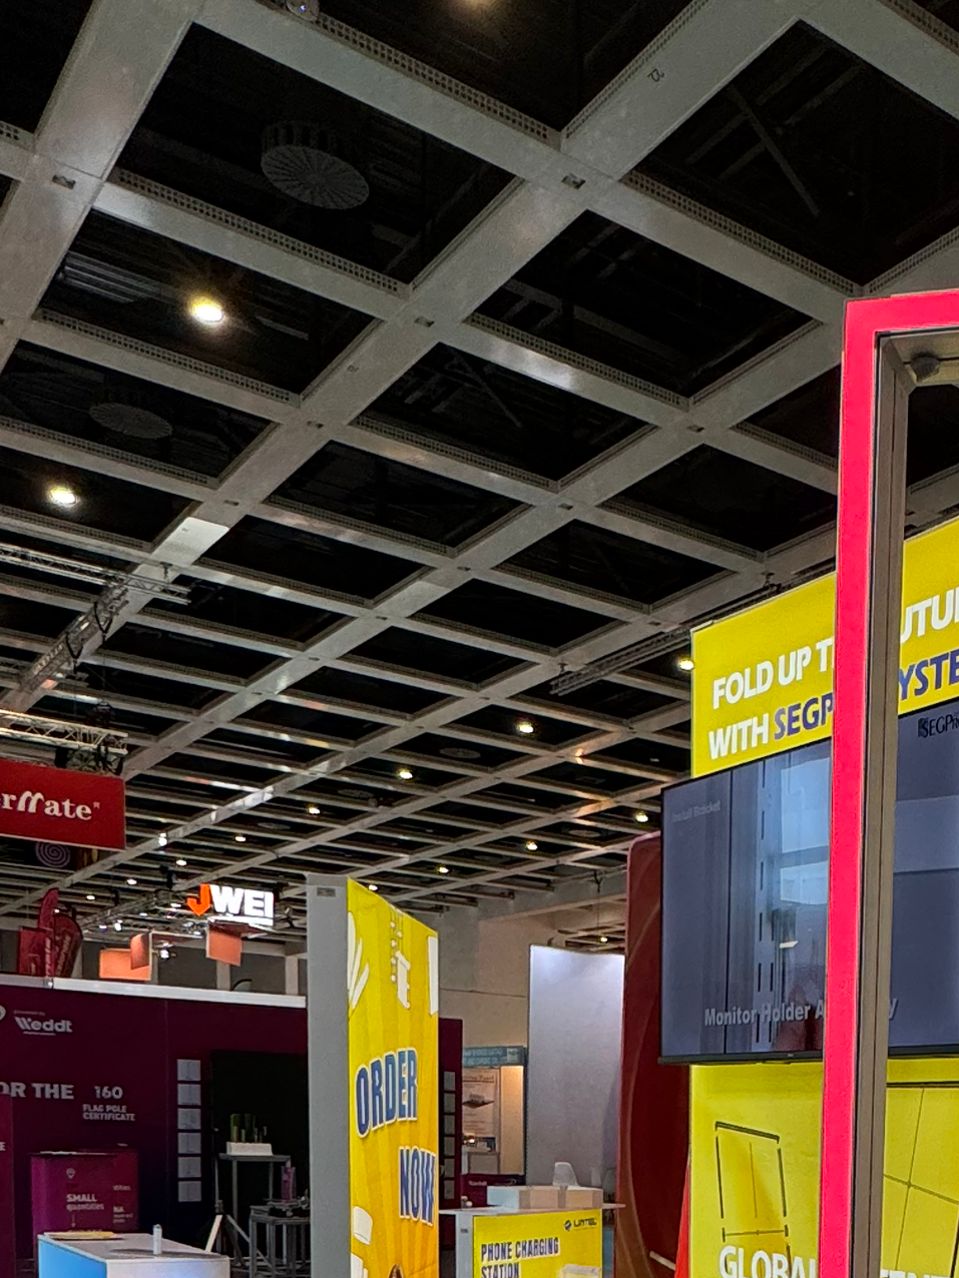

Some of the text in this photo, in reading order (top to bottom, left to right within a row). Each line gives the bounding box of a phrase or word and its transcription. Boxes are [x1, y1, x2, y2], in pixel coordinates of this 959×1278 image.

[712, 660, 773, 709] FOLD
[778, 646, 812, 686] UP
[709, 713, 769, 760] WITH
[774, 692, 834, 740] SEGP
[187, 883, 274, 918] JWEI
[14, 1016, 73, 1032] Weddt
[704, 1006, 757, 1026] Monitor
[760, 1002, 811, 1022] Holder
[31, 1083, 75, 1099] THE
[94, 1086, 123, 1099] 160
[355, 1047, 418, 1138] ORDER
[82, 1103, 127, 1113] FLAG POLE
[82, 1112, 136, 1121] CERTIFICATE
[399, 1146, 436, 1226] NOW
[481, 1237, 559, 1261] PHONE CHARGING
